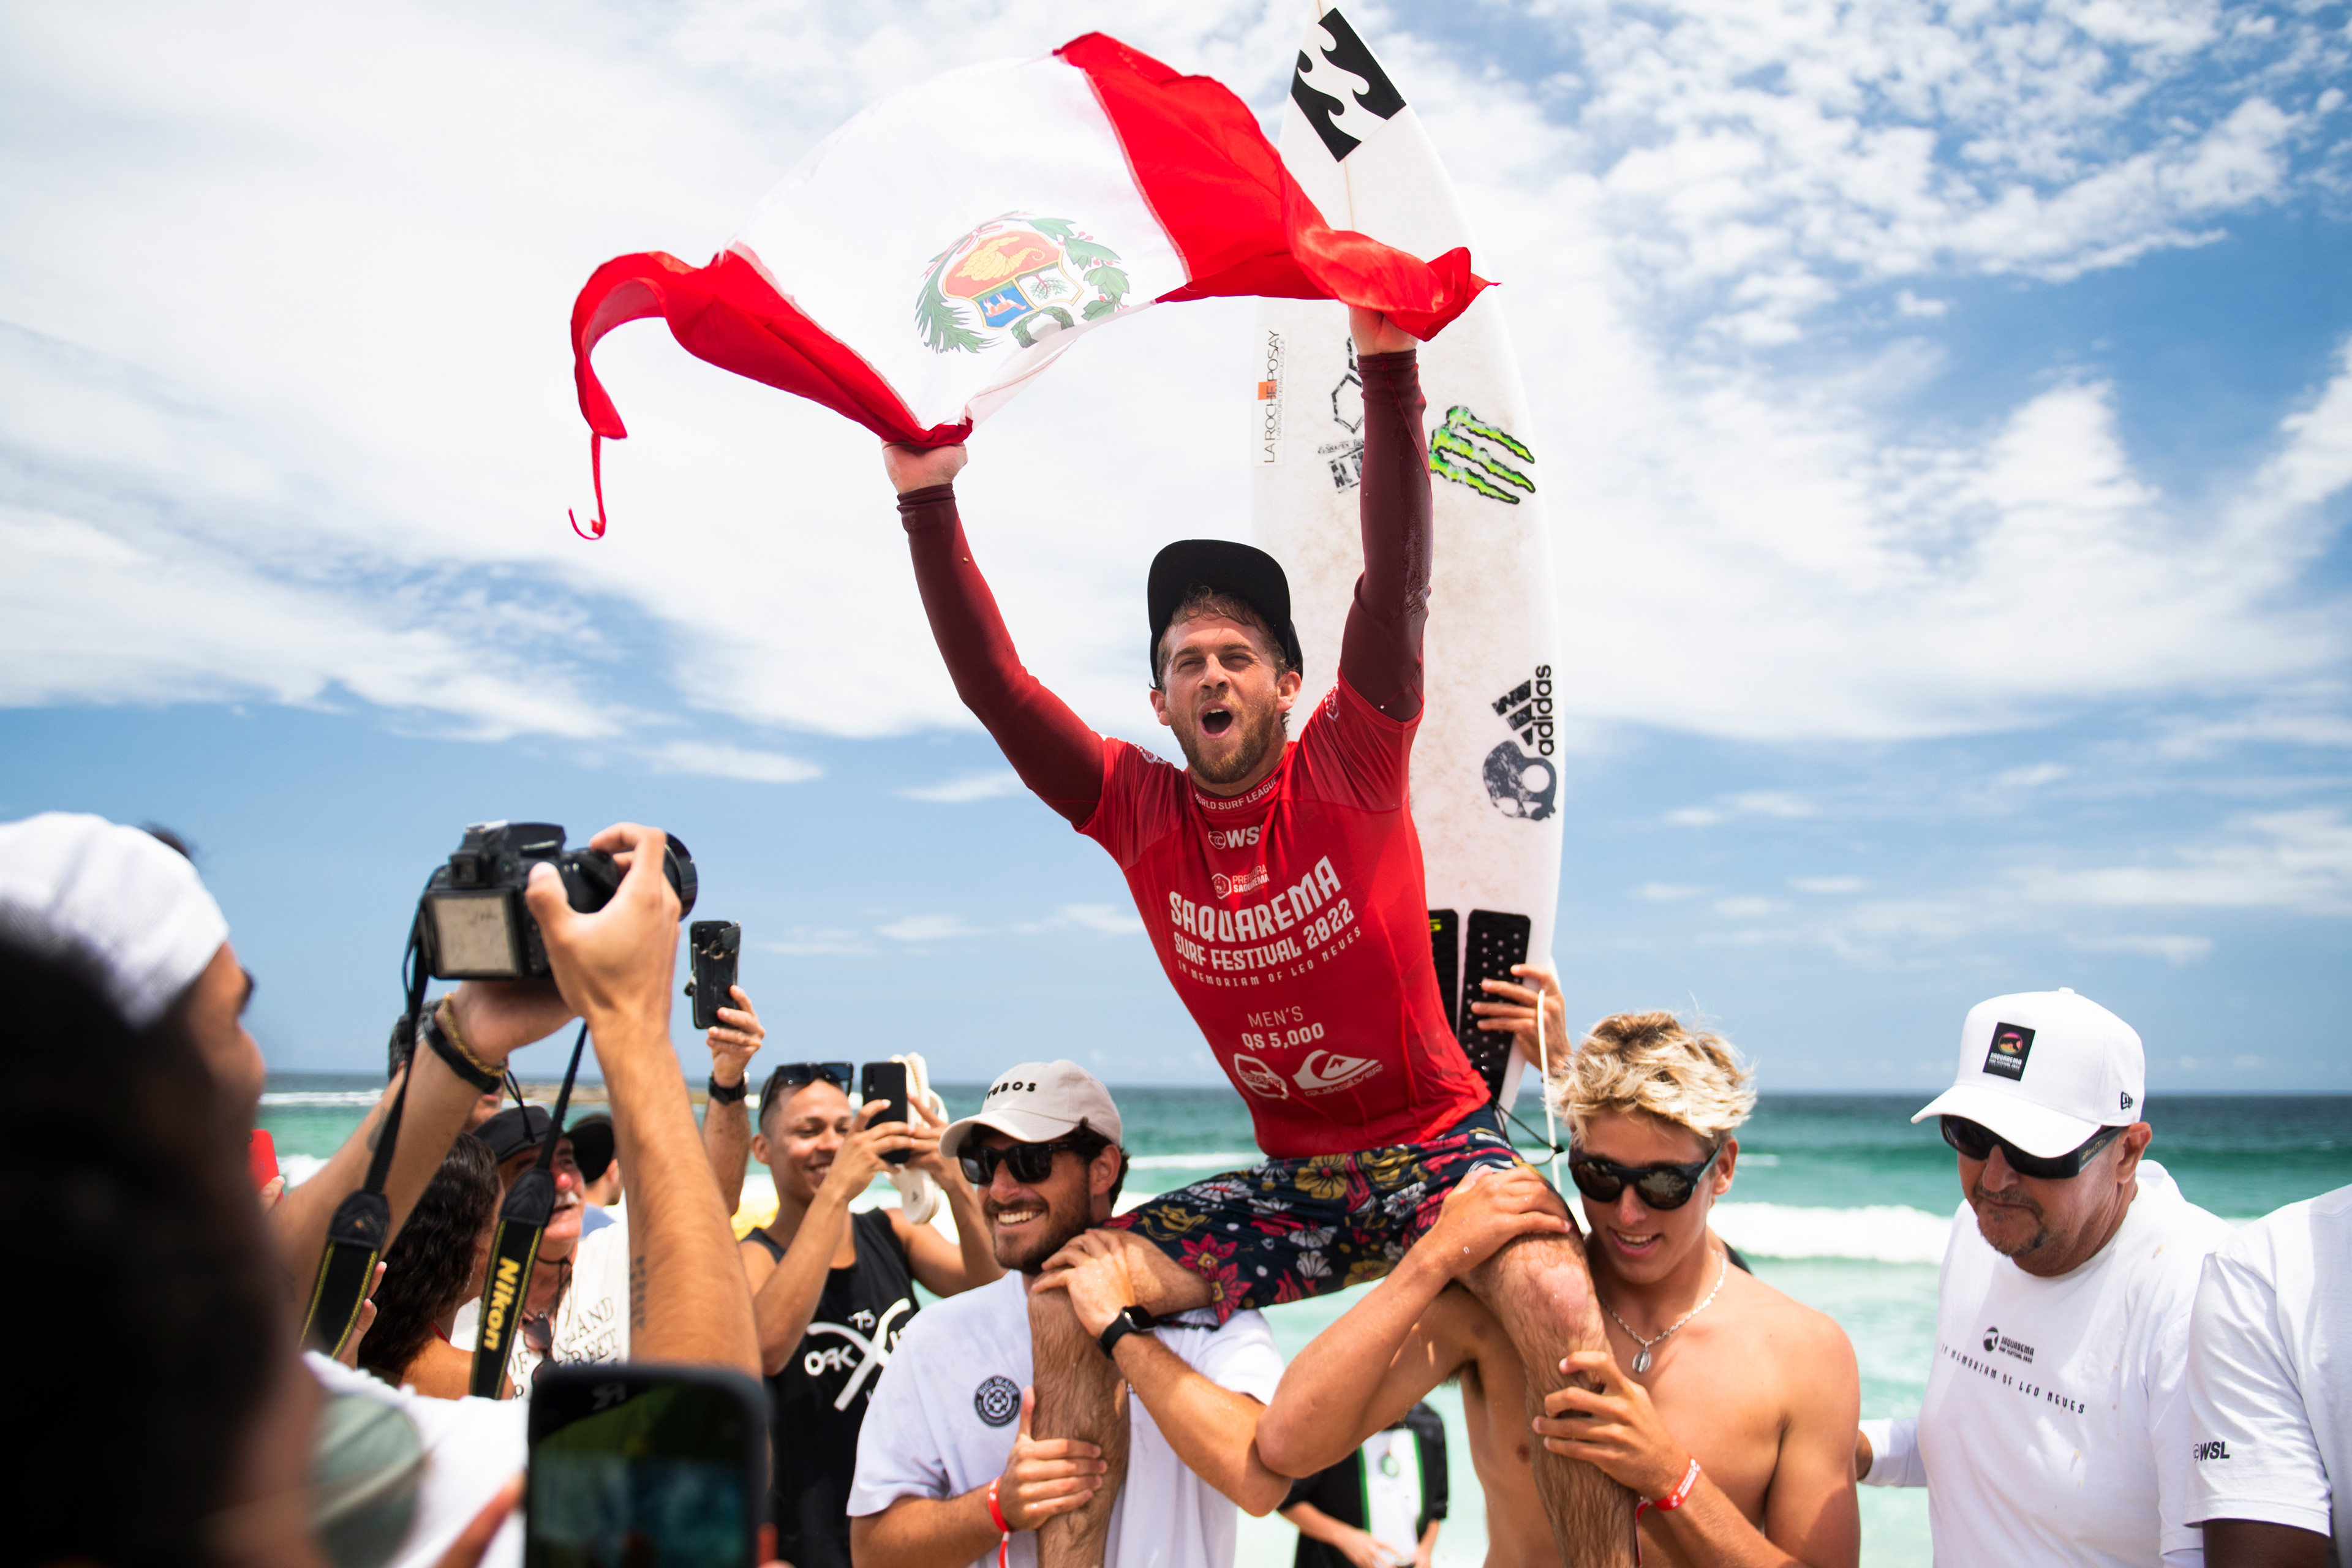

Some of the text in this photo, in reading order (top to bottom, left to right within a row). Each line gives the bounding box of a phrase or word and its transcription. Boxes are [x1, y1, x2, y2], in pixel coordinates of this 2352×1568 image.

[1264, 442, 1275, 463] LA
[1536, 665, 1555, 756] adidas
[1195, 776, 1278, 810] WORLD SURF LEAGUE
[1226, 825, 1264, 848] WS
[1169, 856, 1341, 942] SAQUAREMA
[1174, 898, 1354, 971] SURF FESTIVAL 2022
[1191, 968, 1260, 987] MEMORIAM
[1268, 971, 1283, 982] OF
[1291, 960, 1314, 976] LEO
[1322, 926, 1361, 962] NEVES
[1247, 1006, 1303, 1028] MEN'S
[1242, 1022, 1324, 1051] QS 5,000
[987, 1081, 1036, 1099] TUBOS
[484, 1256, 521, 1351] Nikon
[2000, 1336, 2034, 1356] SAQUAREMA
[978, 1378, 1017, 1396] BIG WAVE
[1951, 1349, 1997, 1378] MEMORIAM
[2002, 1373, 2012, 1386] OF
[2019, 1381, 2040, 1397] LEO
[2048, 1392, 2084, 1414] NEVES
[2200, 1441, 2230, 1461] WSL
